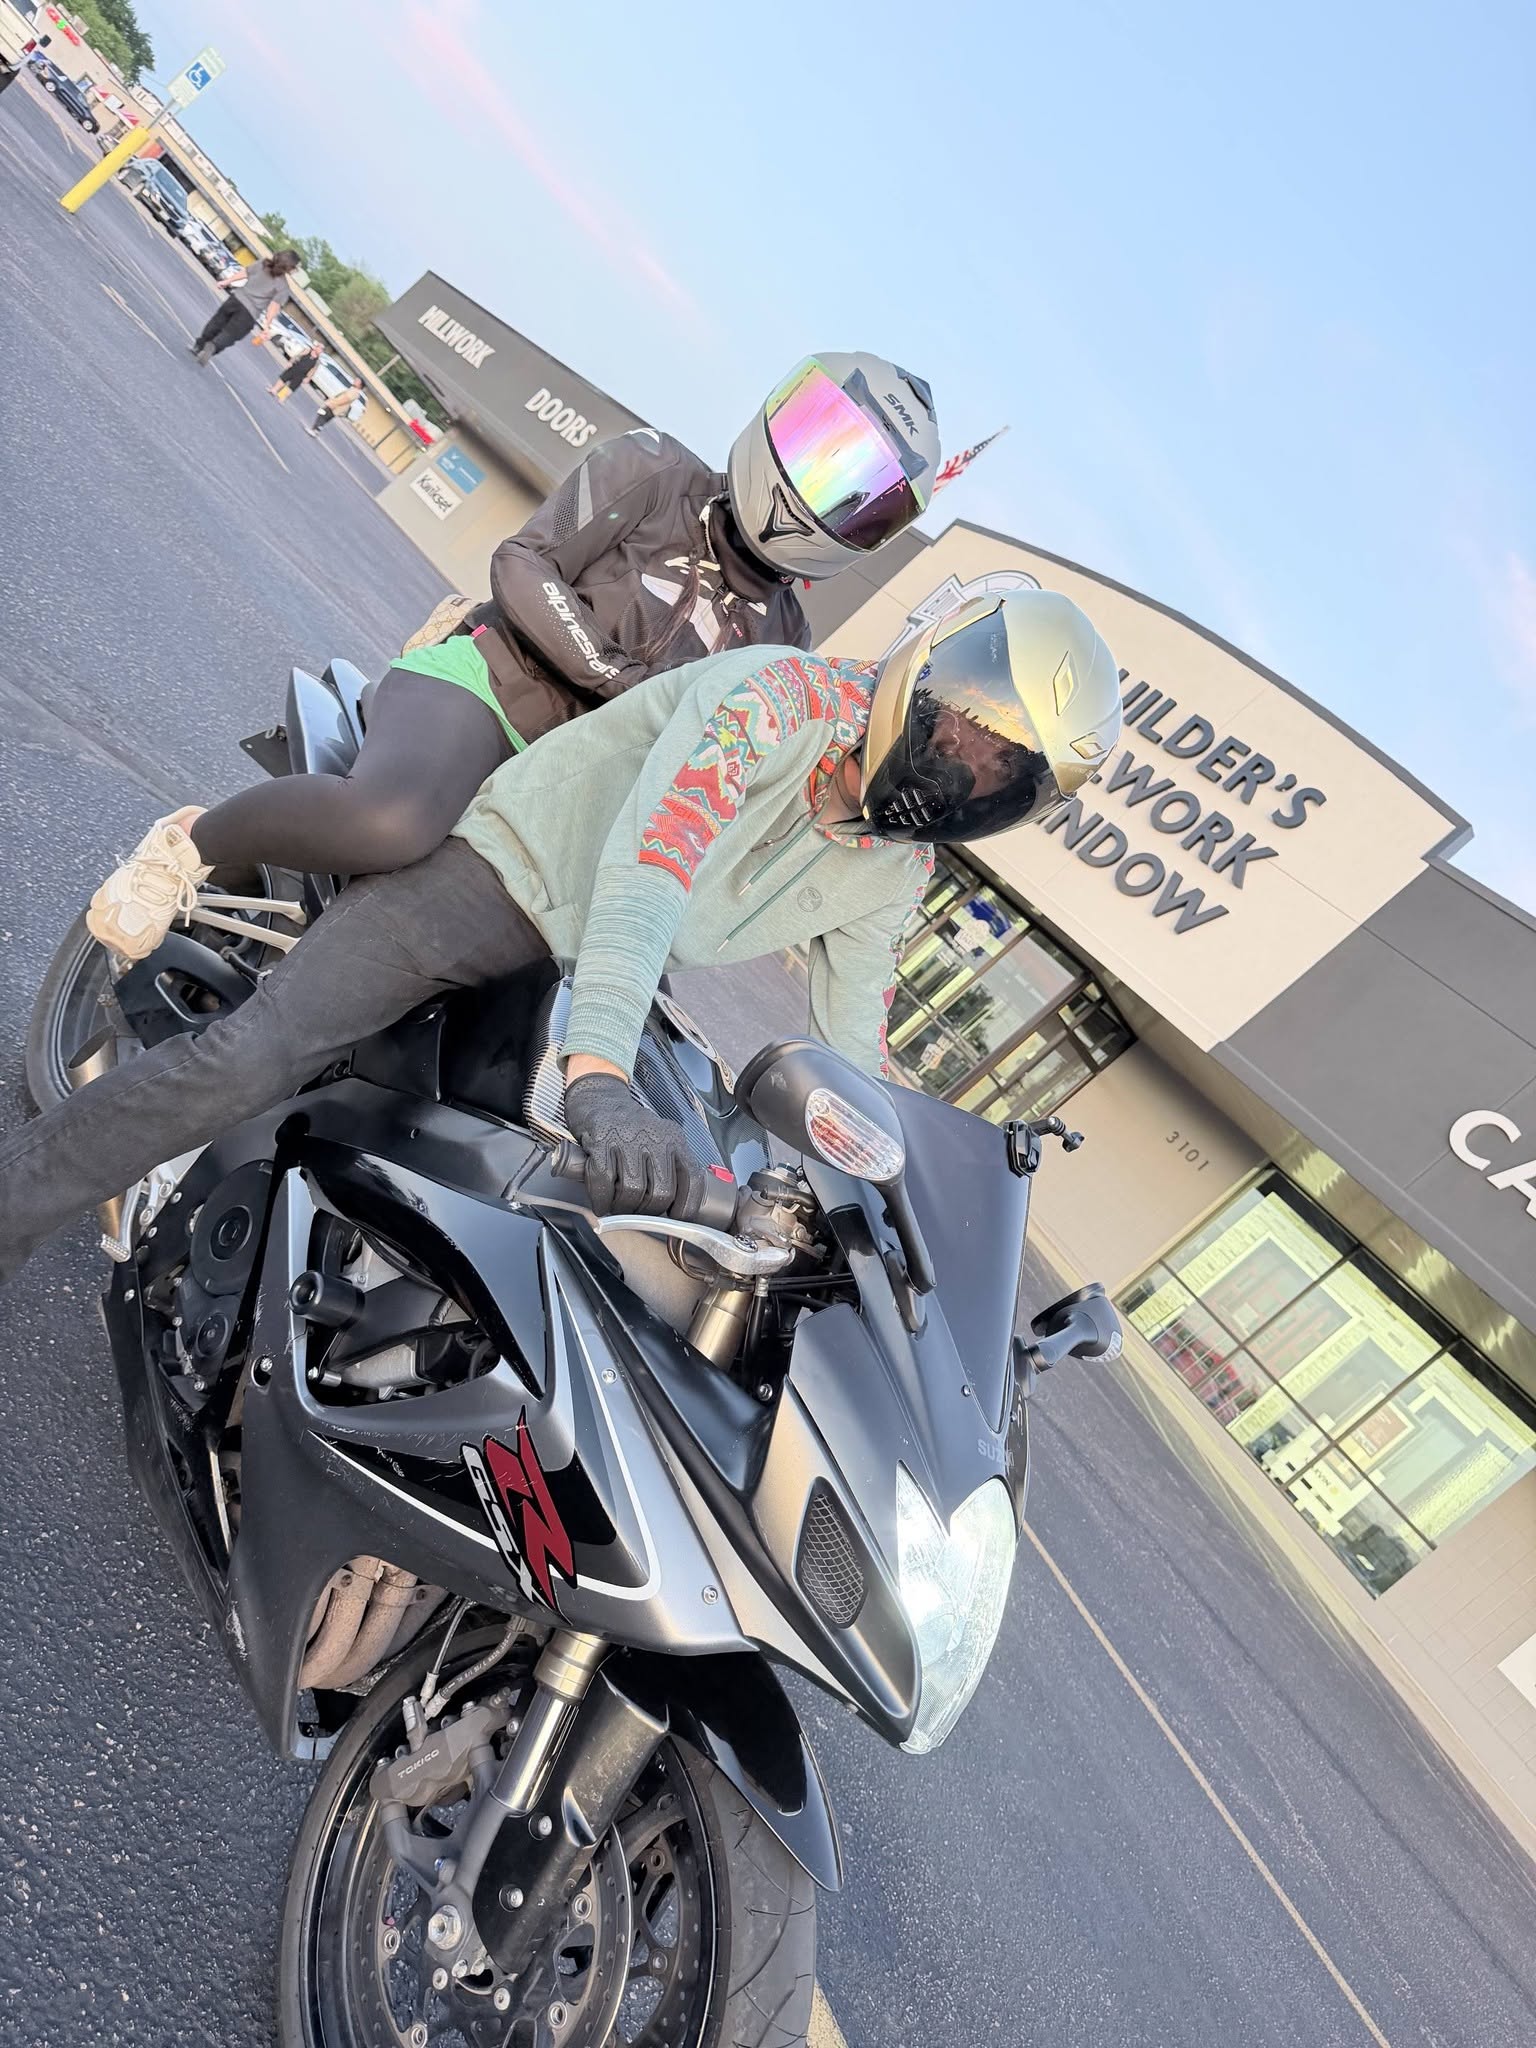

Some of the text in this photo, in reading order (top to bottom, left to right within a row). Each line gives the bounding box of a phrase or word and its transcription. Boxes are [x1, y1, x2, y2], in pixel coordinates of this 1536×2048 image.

[418, 304, 496, 369] MILLWORK
[525, 387, 598, 448] DOORS
[883, 393, 919, 437] SMK
[542, 582, 620, 680] alpinestars
[1118, 667, 1328, 830] UILDER'S
[1035, 797, 1231, 935] NDOW
[1165, 1130, 1209, 1171] 3101
[397, 1749, 440, 1778] TOKICO
